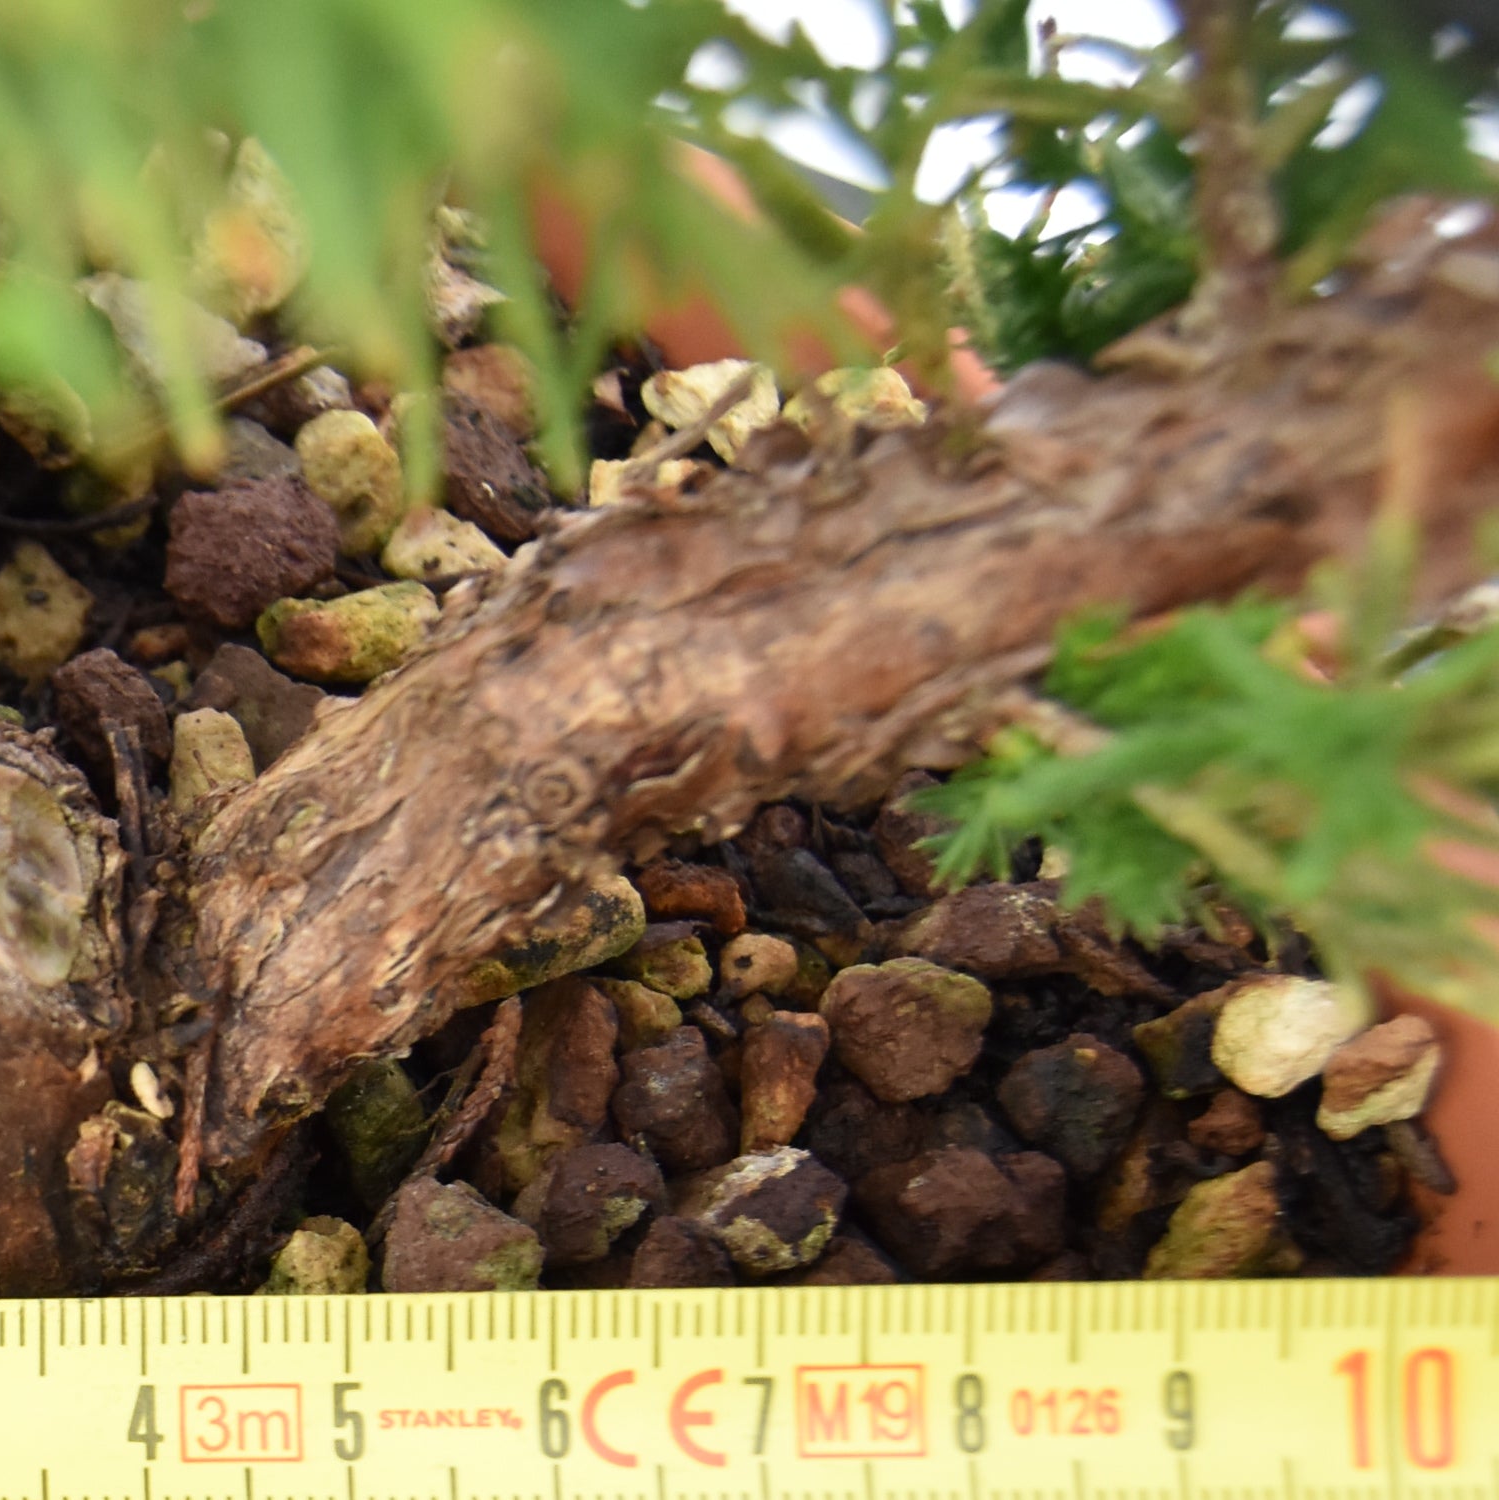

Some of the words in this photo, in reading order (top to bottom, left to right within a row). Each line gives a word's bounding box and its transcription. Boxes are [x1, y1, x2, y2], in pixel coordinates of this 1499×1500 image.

[127, 1384, 165, 1461] 4
[196, 1395, 292, 1452] 3m
[333, 1381, 364, 1461] 5
[538, 1378, 570, 1459] 6
[742, 1376, 775, 1456] 7
[954, 1372, 987, 1453] 8
[1009, 1388, 1122, 1437] 0126
[1164, 1370, 1196, 1451] 9
[1334, 1347, 1456, 1470] 10
